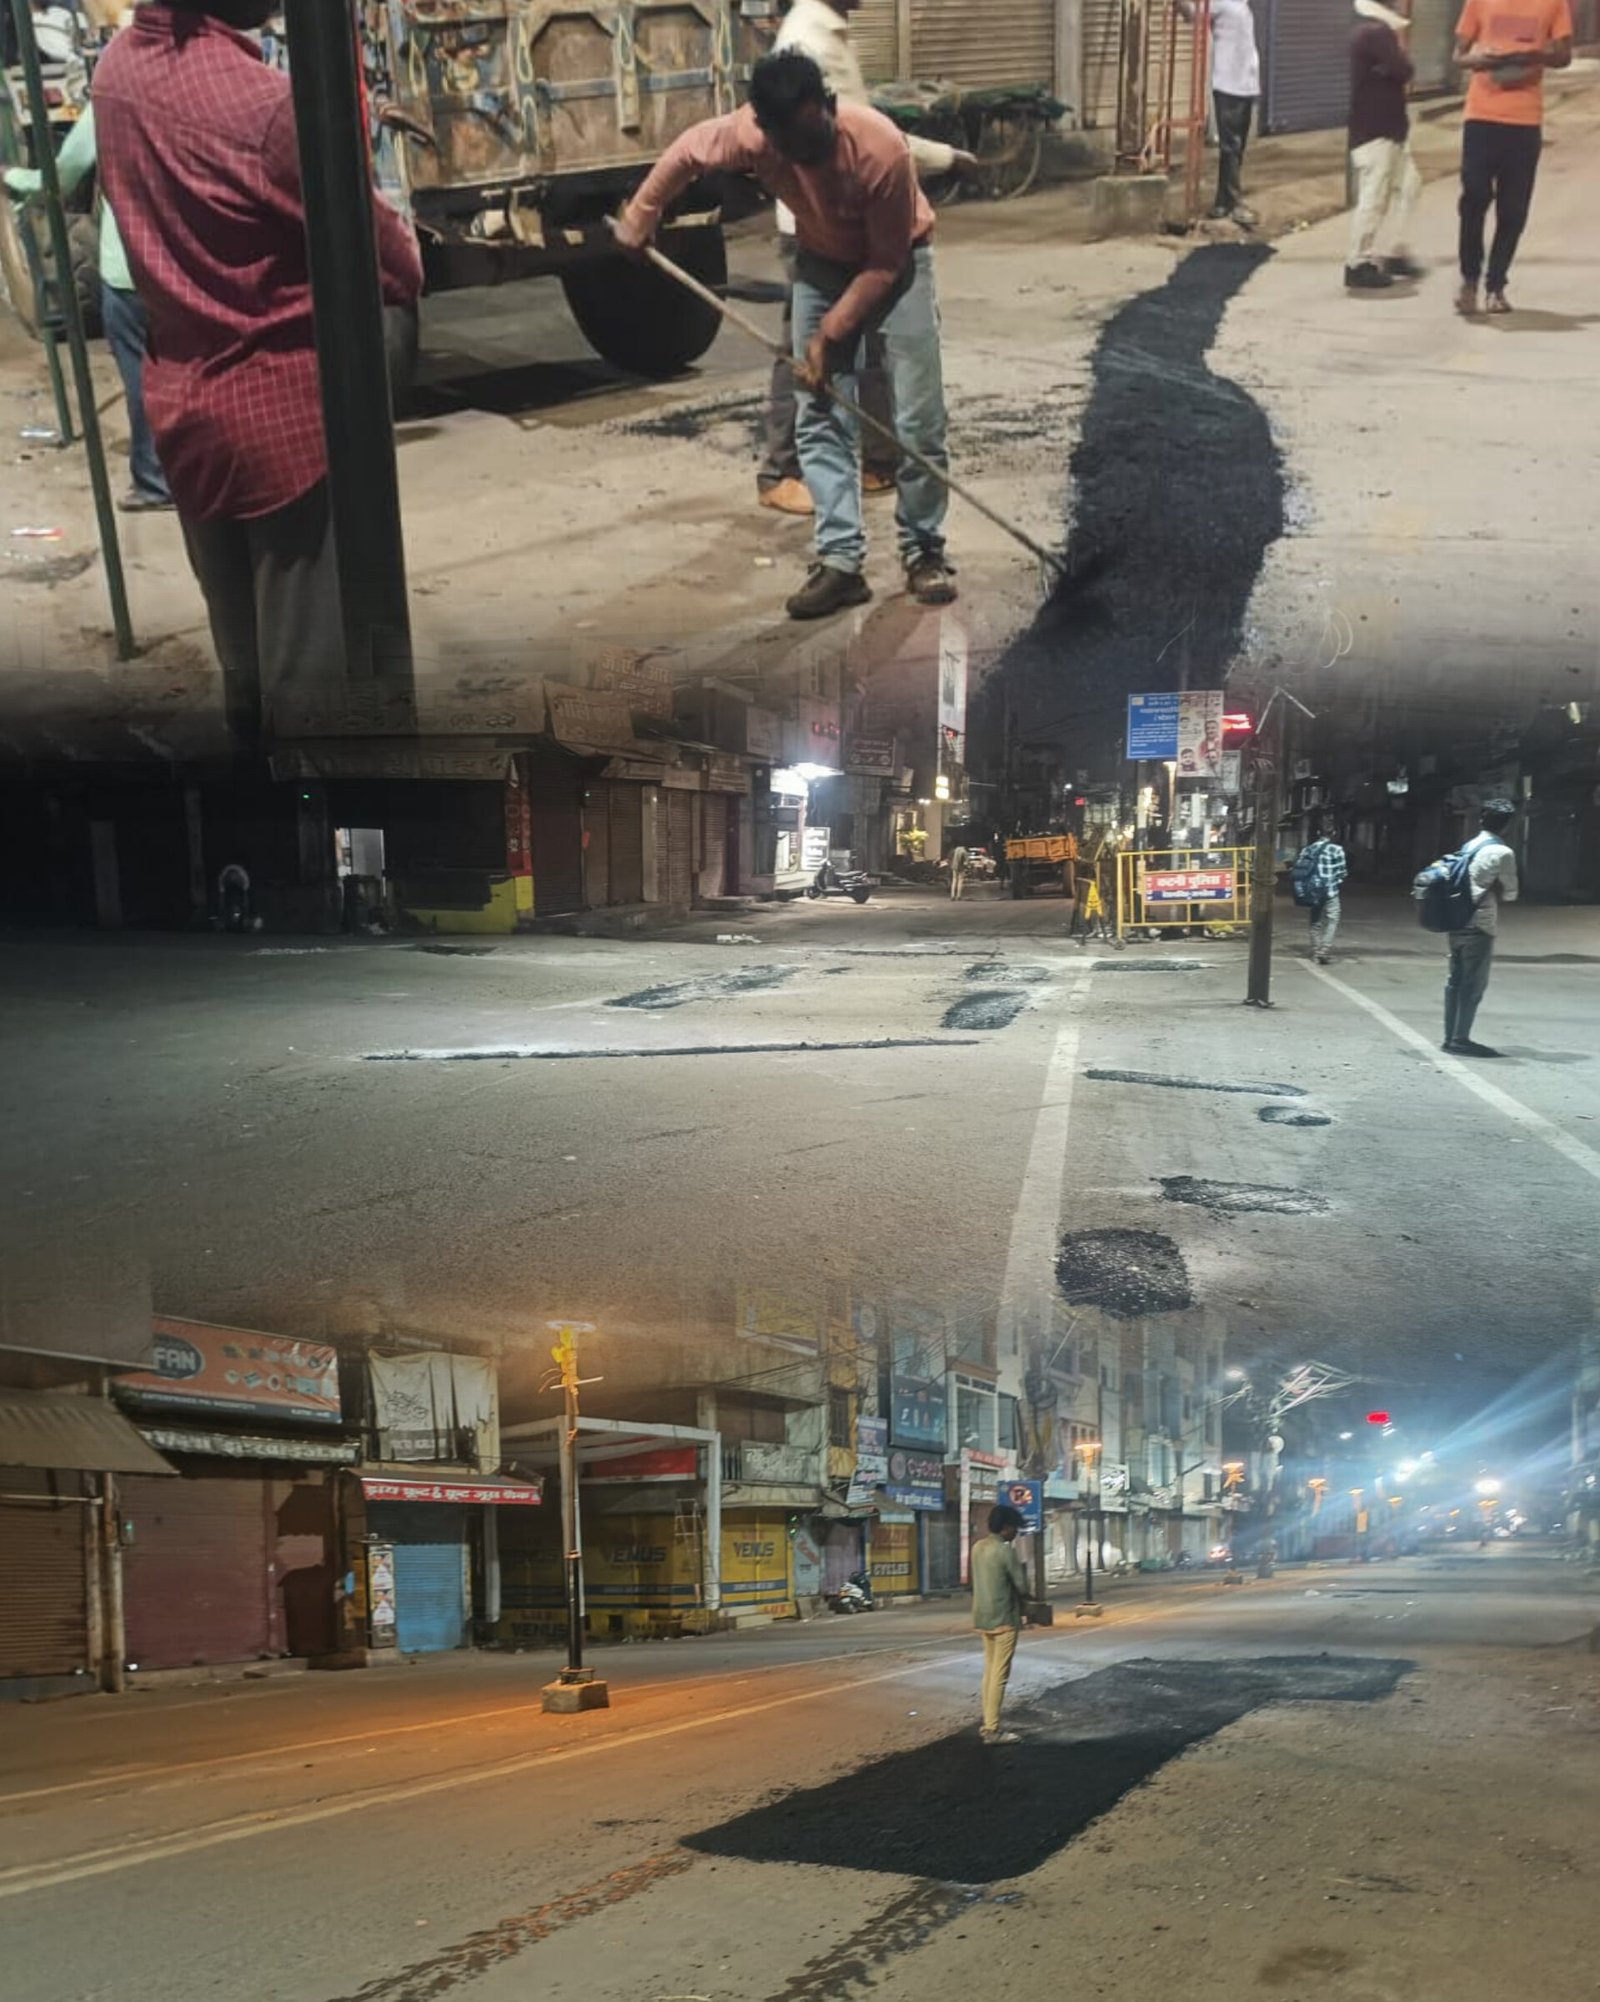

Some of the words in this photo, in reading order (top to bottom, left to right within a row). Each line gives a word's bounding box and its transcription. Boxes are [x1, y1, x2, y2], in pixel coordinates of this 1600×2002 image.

[1156, 874, 1186, 887] कटनी
[1188, 873, 1221, 889] पुलिस
[733, 1541, 775, 1558] VENUS
[873, 1563, 910, 1576] CYCLES
